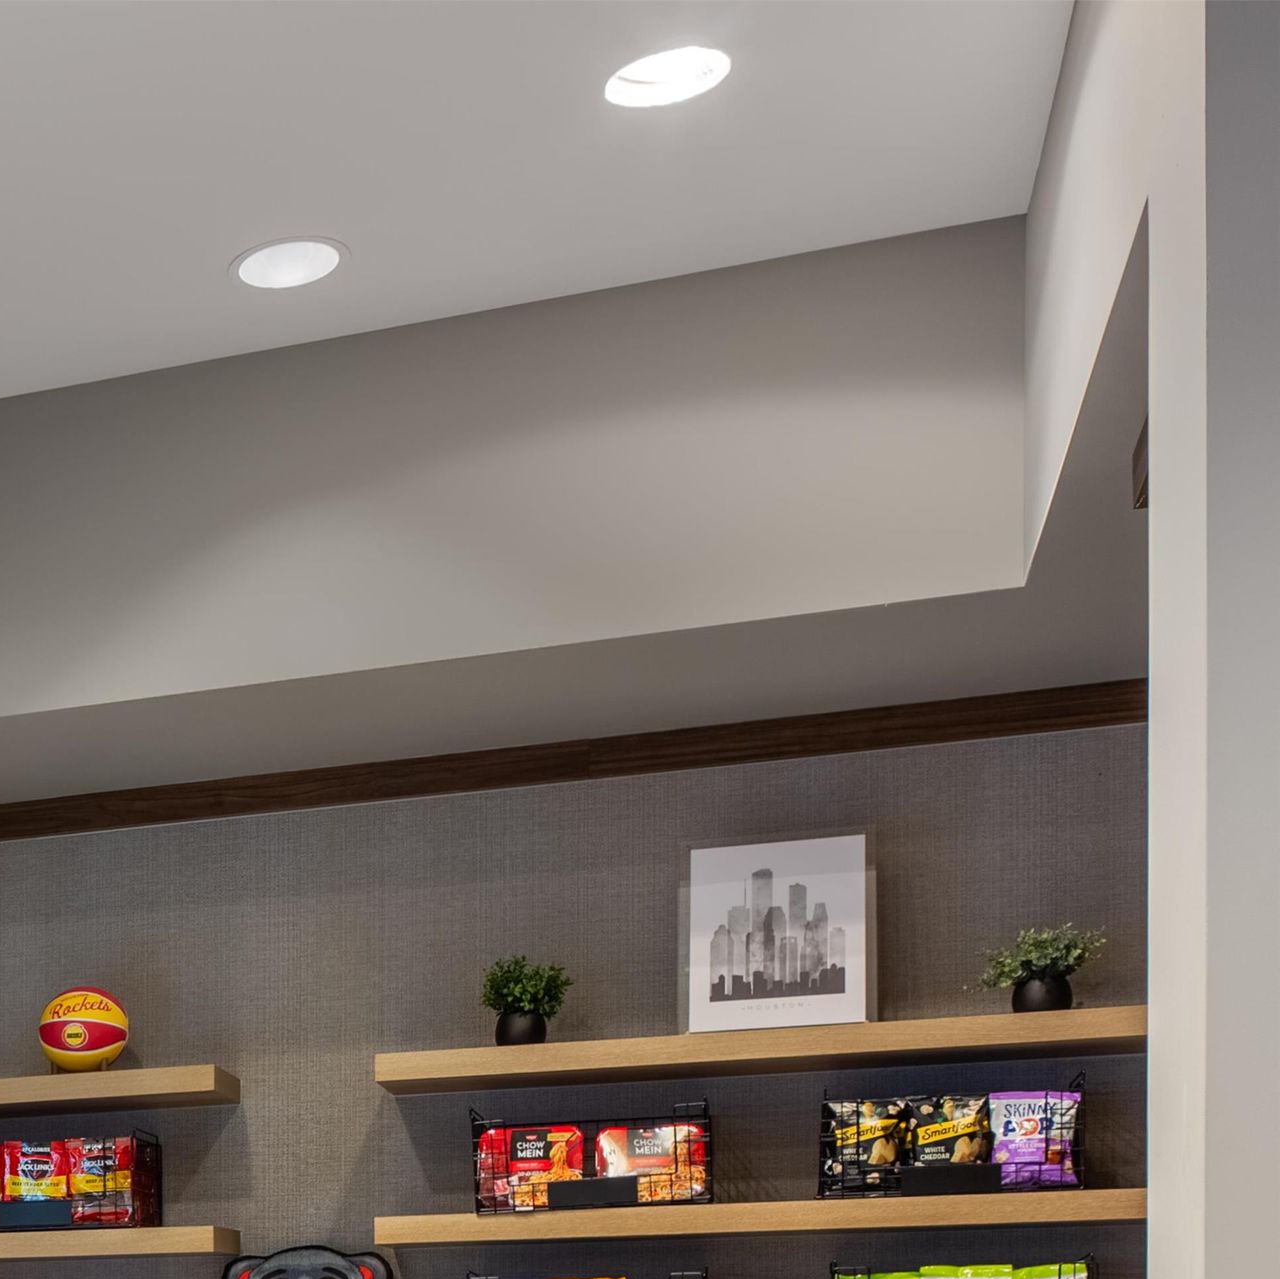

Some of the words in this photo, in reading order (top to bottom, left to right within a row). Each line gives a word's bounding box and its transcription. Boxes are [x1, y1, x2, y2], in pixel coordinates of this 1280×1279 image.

[48, 996, 113, 1020] Rockets
[1003, 1102, 1056, 1119] SKINNY
[1002, 1118, 1056, 1137] POP
[516, 1140, 546, 1151] CHOW
[633, 1138, 663, 1148] CHOW
[517, 1149, 544, 1159] MEIN
[635, 1146, 662, 1155] MEIN
[924, 1145, 946, 1153] WHITE
[919, 1152, 950, 1161] CHEDDAR
